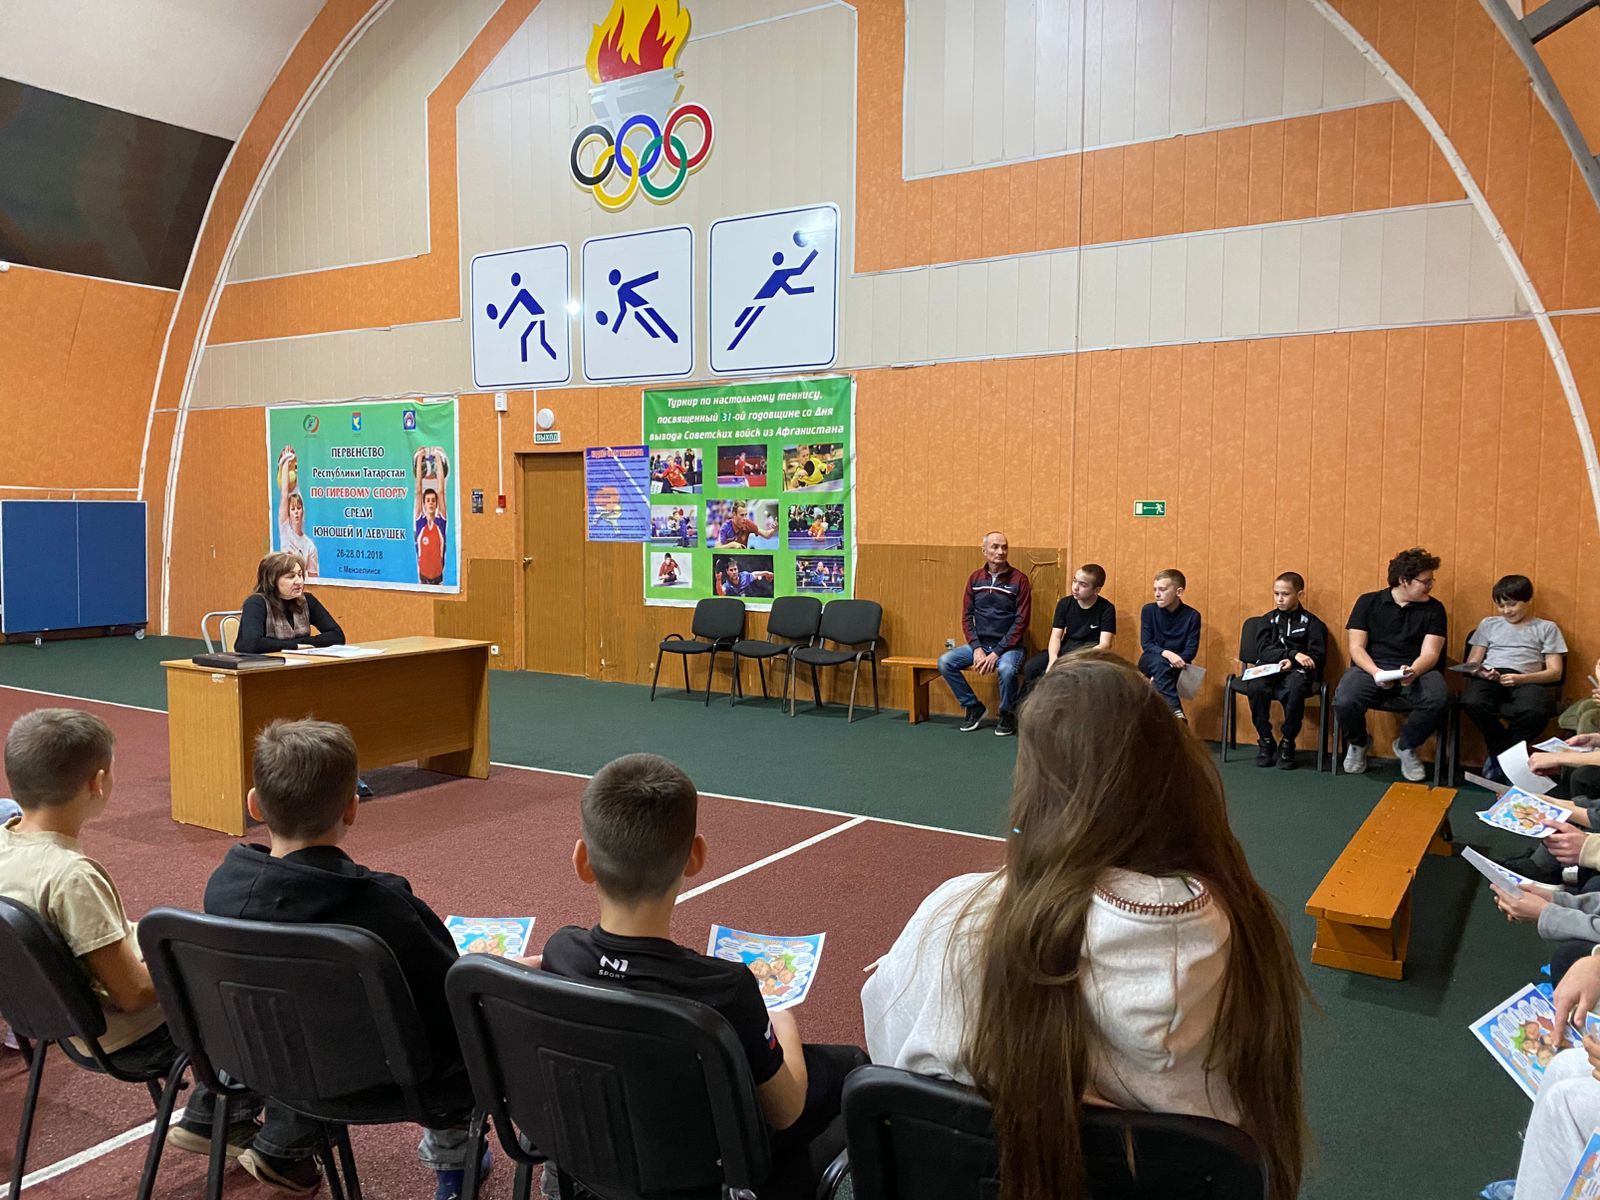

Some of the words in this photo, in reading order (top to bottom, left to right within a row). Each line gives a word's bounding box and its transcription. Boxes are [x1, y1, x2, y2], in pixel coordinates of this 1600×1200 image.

[667, 398, 698, 408] Турнир
[713, 393, 775, 404] настольному
[657, 413, 719, 424] посвященный
[748, 409, 801, 422] годовщине
[802, 408, 812, 417] со
[814, 406, 834, 417] Дня
[536, 433, 559, 442] ВЫХОД
[649, 432, 682, 442] вывода
[684, 430, 732, 440] Советских
[735, 427, 761, 438] войск
[763, 428, 774, 437] из
[775, 425, 844, 438] Афганистана
[331, 446, 385, 458] ПЕРВЕНСТВО
[312, 467, 360, 480] Республики
[363, 467, 405, 480] Татарстан
[311, 487, 324, 498] ПО
[326, 487, 370, 498] ГИРЕВОМУ
[373, 487, 407, 498] СПОРТУ
[344, 507, 373, 518] СРЕДИ
[313, 525, 354, 538] ЮНОШЕЙ
[356, 528, 363, 538] И
[365, 528, 405, 539] ДЕВУШЕК
[336, 549, 384, 560] 26-28.01.2018
[598, 969, 626, 980] SPORT
